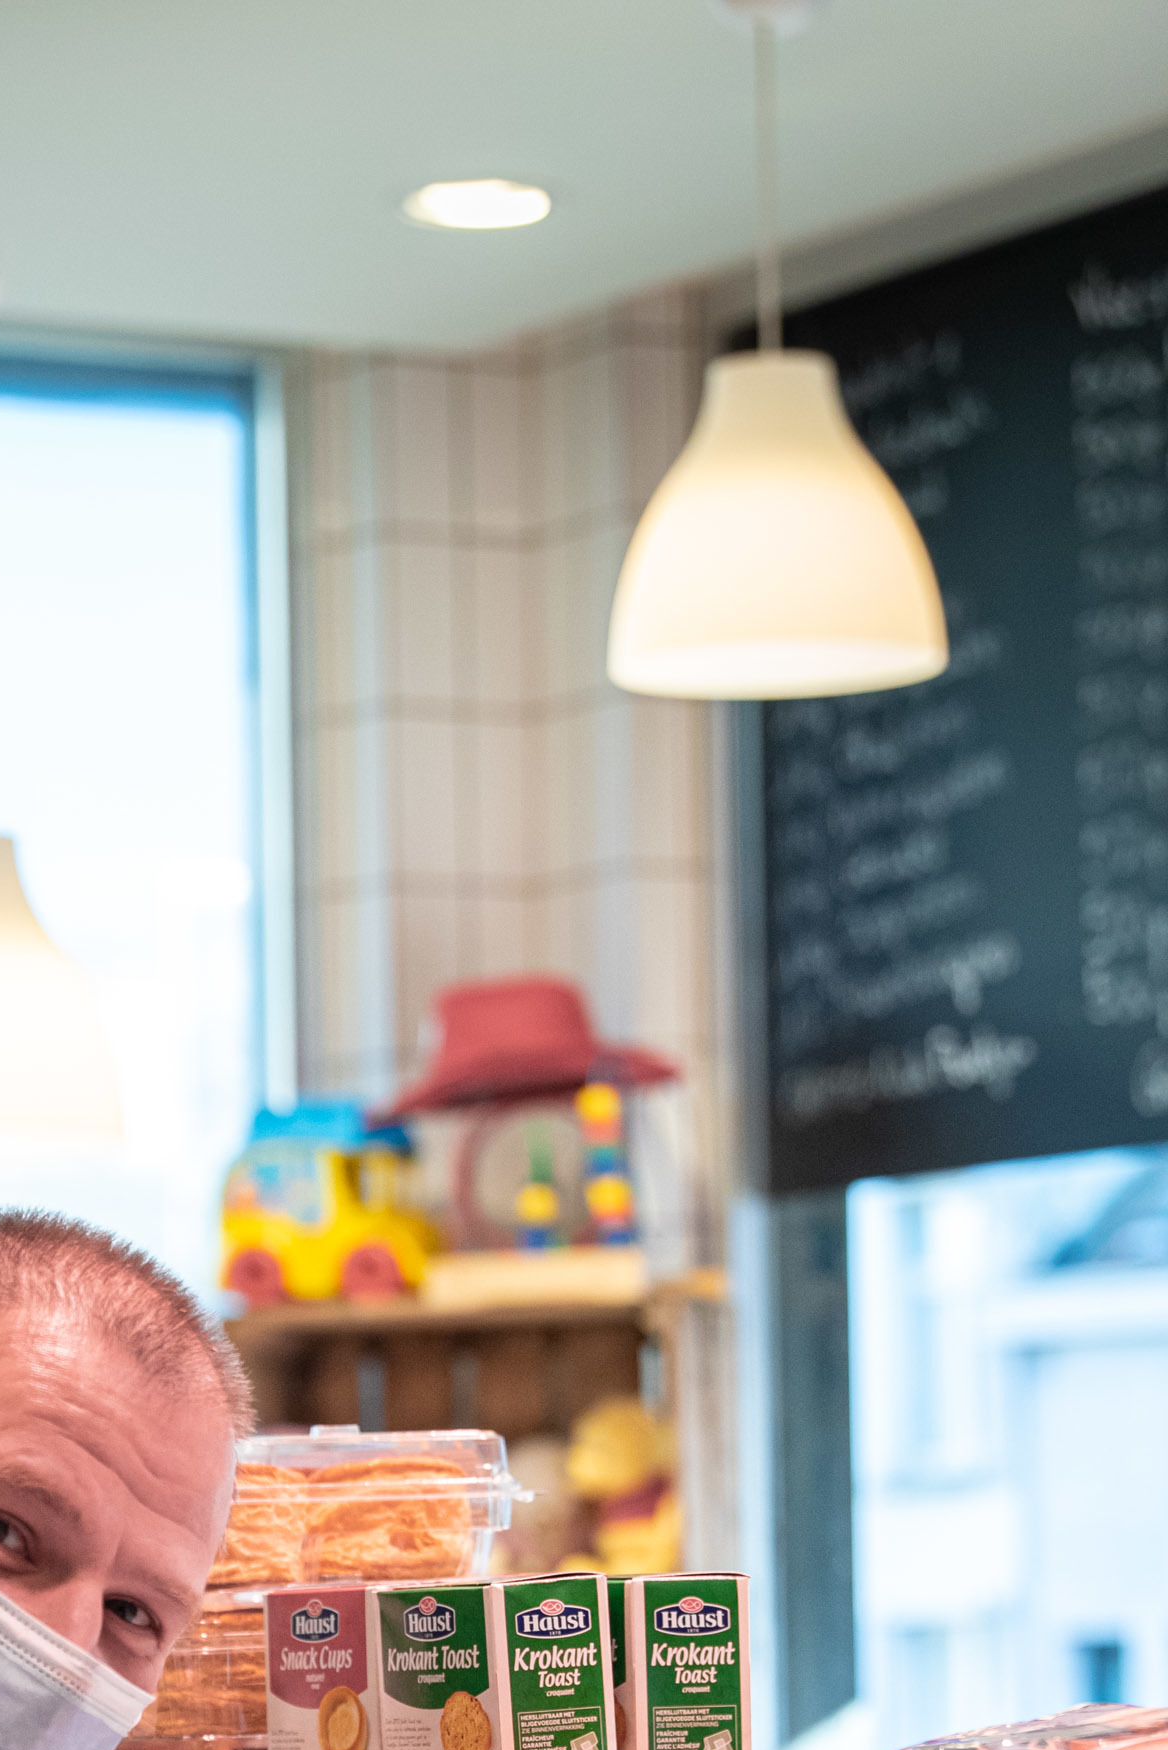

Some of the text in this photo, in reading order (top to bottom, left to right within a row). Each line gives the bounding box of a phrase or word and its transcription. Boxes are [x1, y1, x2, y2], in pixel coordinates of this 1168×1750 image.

[295, 1614, 336, 1635] Haust
[408, 1611, 452, 1633] Haust
[522, 1611, 587, 1633] Haust
[661, 1610, 725, 1629] Haust
[280, 1645, 353, 1673] Snack Cups
[387, 1644, 480, 1672] Krokant Toast
[513, 1642, 598, 1671] Krokant
[651, 1641, 736, 1667] Krokant
[417, 1672, 446, 1684] croquant
[538, 1668, 581, 1688] Toast
[674, 1666, 718, 1684] Toast
[546, 1688, 575, 1697] croquant
[682, 1685, 711, 1694] croquant
[522, 1741, 552, 1749] GARANTIE
